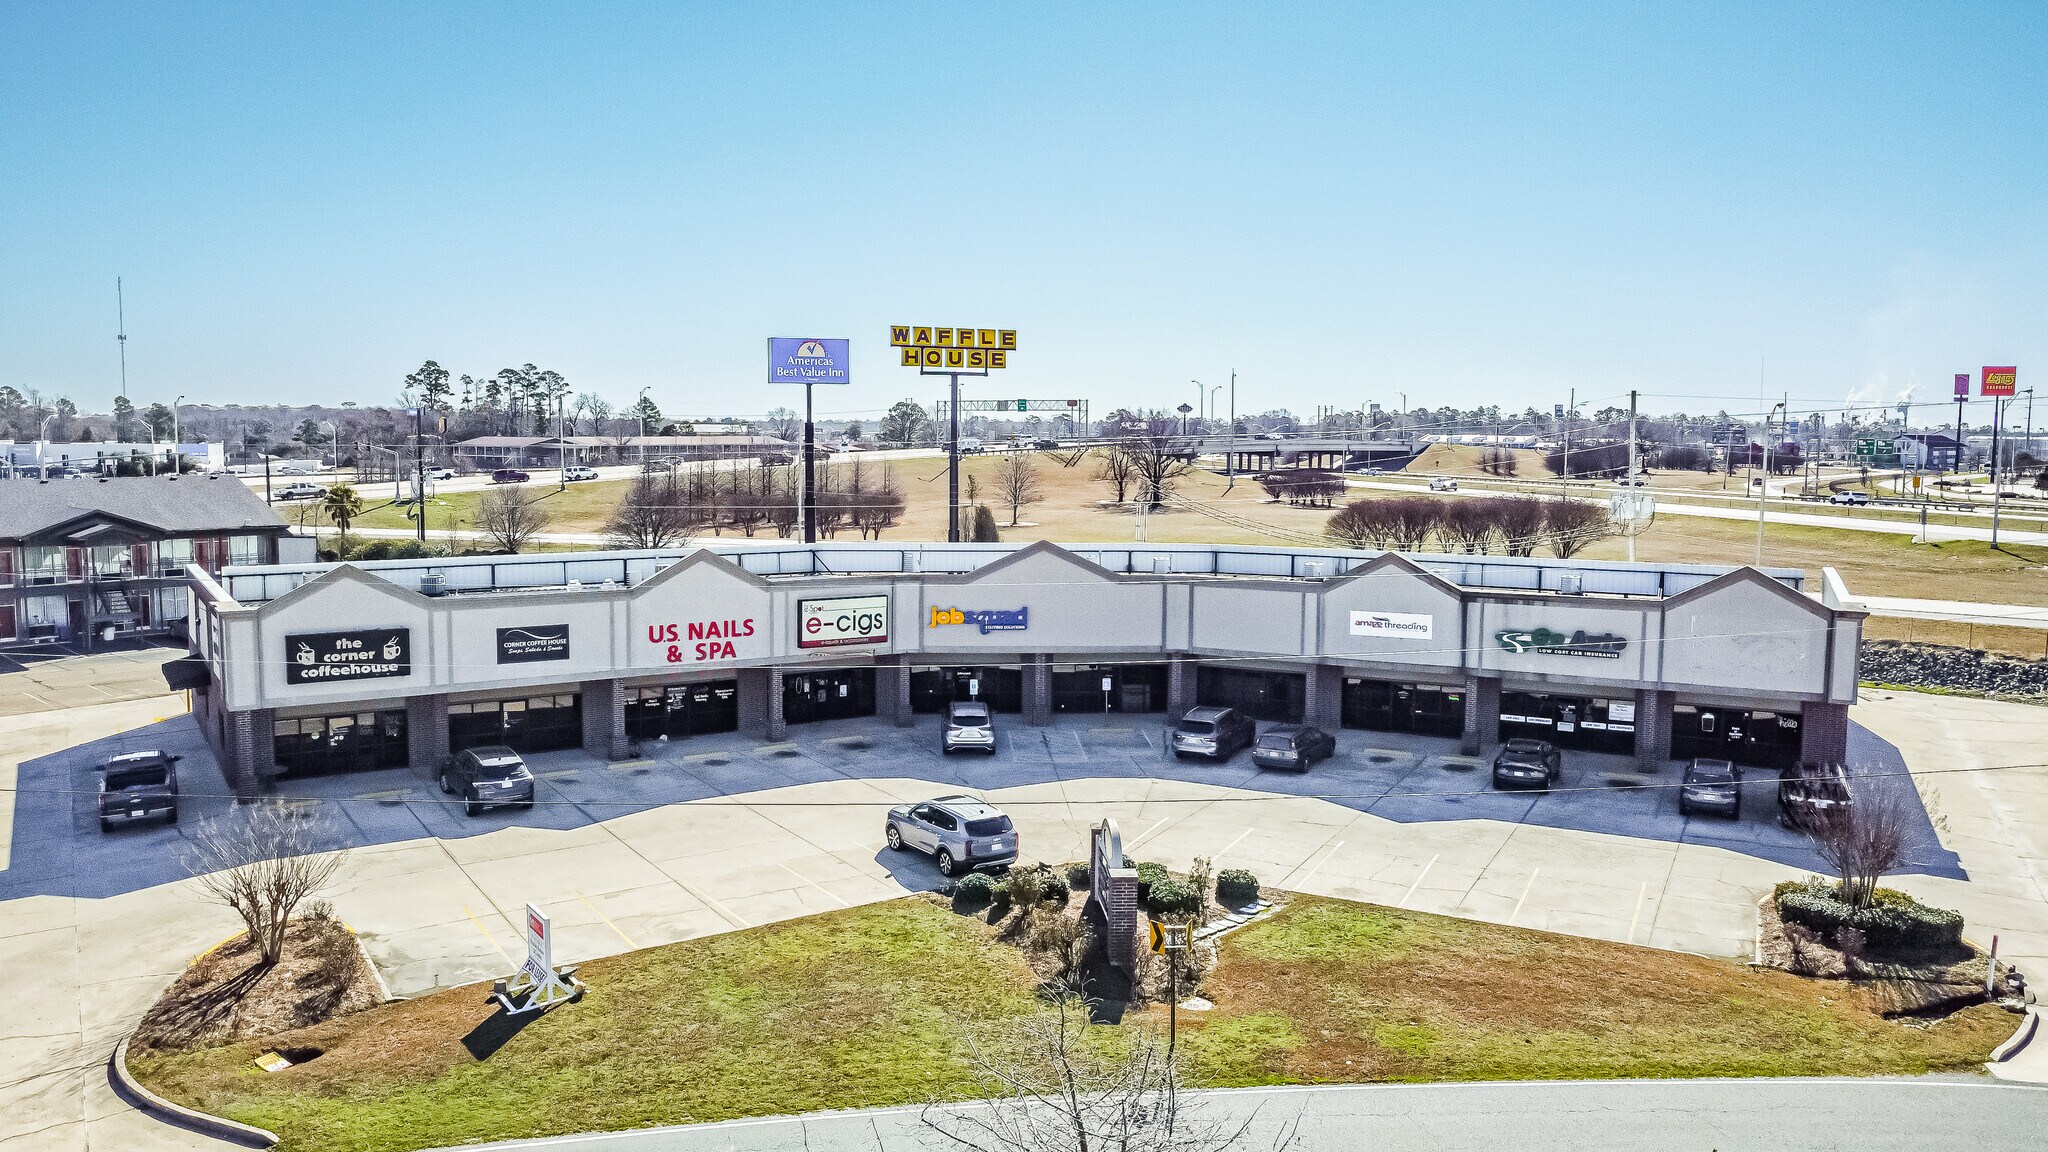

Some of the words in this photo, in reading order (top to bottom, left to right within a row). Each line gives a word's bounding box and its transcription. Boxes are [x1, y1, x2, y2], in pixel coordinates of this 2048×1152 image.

[892, 328, 1015, 346] WAFFLE
[787, 356, 834, 366] Americas
[904, 350, 1004, 366] HOUSE
[777, 367, 798, 376] Best
[800, 367, 826, 377] Value
[829, 368, 844, 377] Inn
[688, 618, 755, 641] NAILS
[806, 610, 883, 636] e-cigs
[1384, 622, 1428, 633] threading
[335, 638, 363, 650] the
[526, 639, 548, 647] COFFEE
[547, 638, 567, 646] HOUSE
[323, 650, 376, 663] corner
[667, 645, 682, 663] &
[695, 641, 737, 661] SPA
[1584, 651, 1618, 659] INSURANCE
[301, 663, 399, 678] coffeehouse
